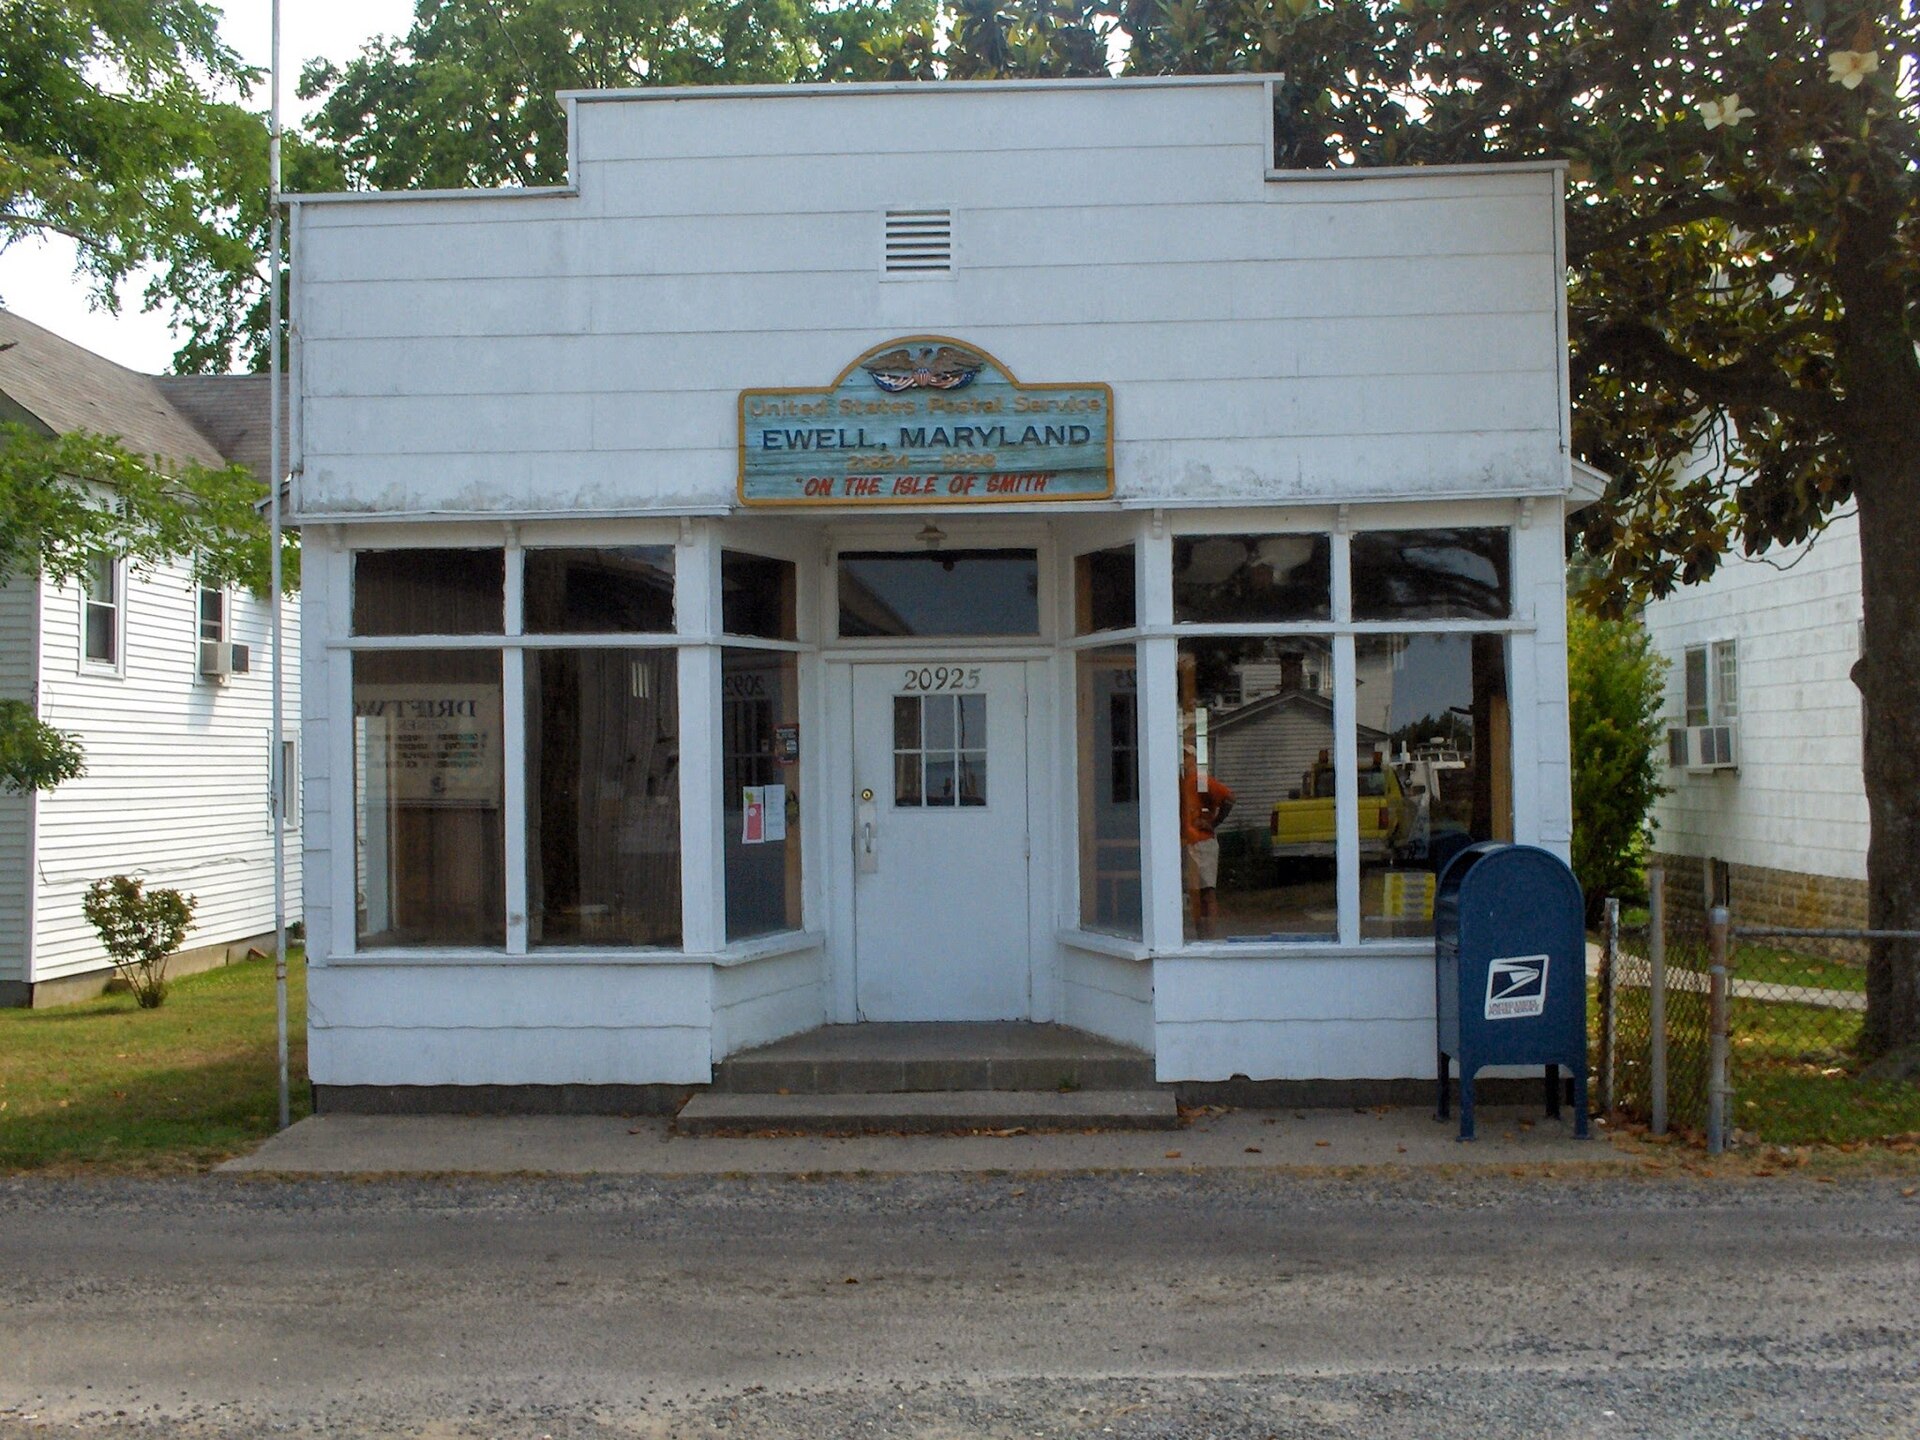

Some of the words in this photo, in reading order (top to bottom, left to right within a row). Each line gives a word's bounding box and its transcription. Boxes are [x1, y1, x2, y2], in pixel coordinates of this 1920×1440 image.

[751, 400, 828, 417] United
[839, 399, 916, 415] States
[928, 397, 1002, 414] Postal
[1014, 395, 1101, 412] Service
[762, 428, 887, 450] EWELL,
[900, 425, 1090, 449] MARYLAND
[845, 476, 882, 496] THE
[893, 475, 938, 495] ISLE
[948, 475, 978, 494] OF
[903, 667, 981, 691] 20925
